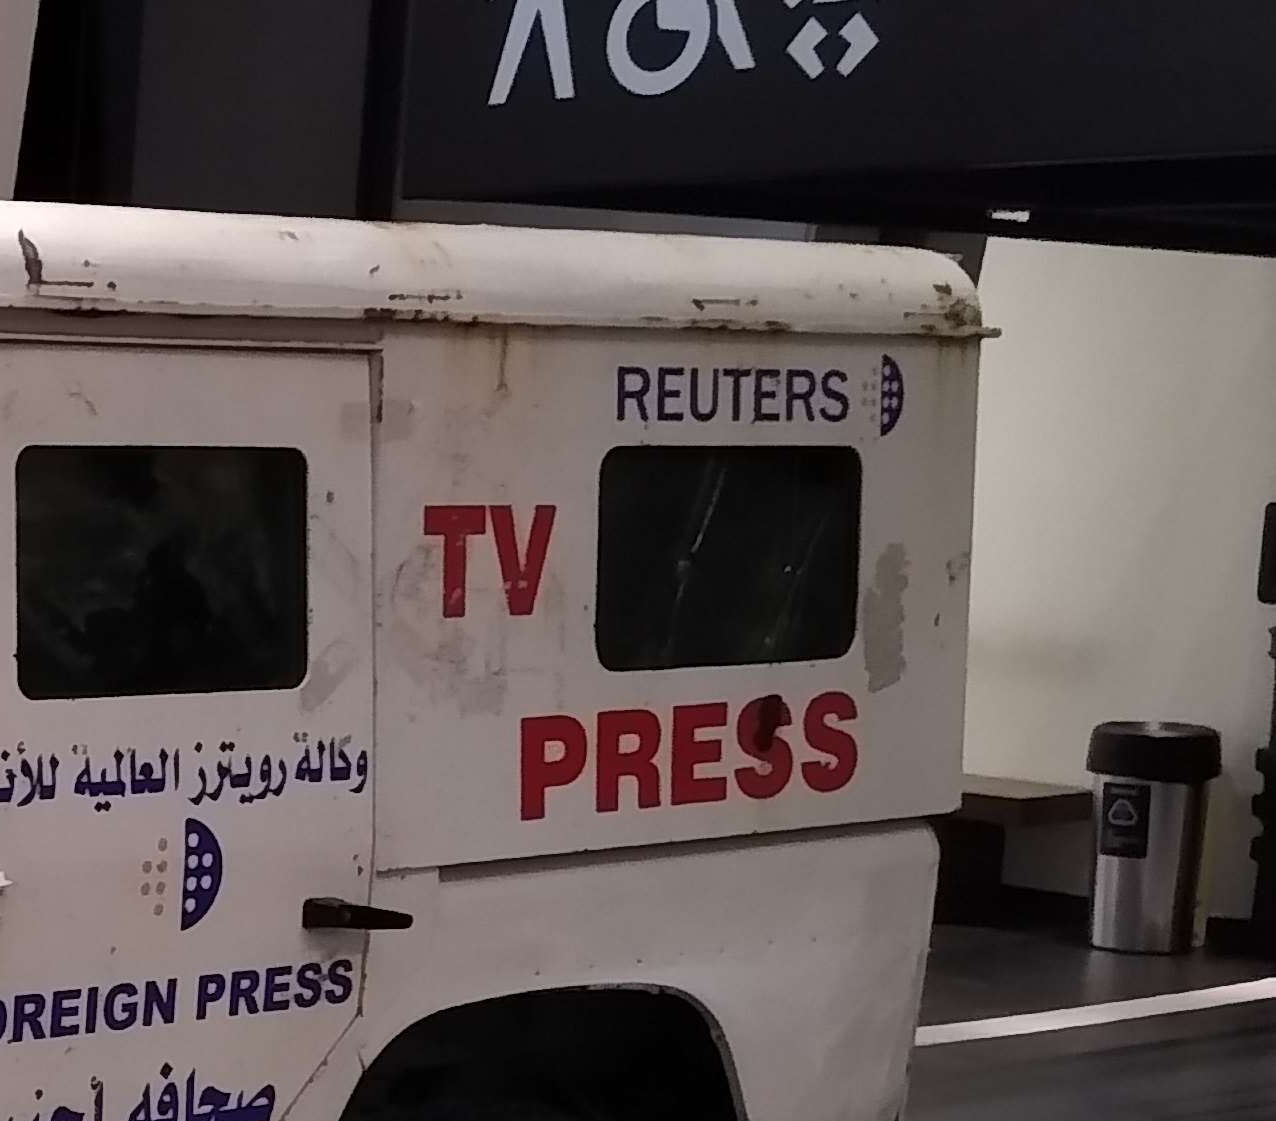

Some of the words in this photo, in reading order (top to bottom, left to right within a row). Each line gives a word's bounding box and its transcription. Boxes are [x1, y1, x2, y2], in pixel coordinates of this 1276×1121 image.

[616, 366, 850, 424] REUTERS
[423, 504, 557, 618] TV
[73, 743, 181, 813] العالمية
[188, 742, 288, 805] رويترز
[292, 732, 369, 793] وكالة
[520, 691, 859, 821] PRESS
[196, 958, 355, 1021] PRESS
